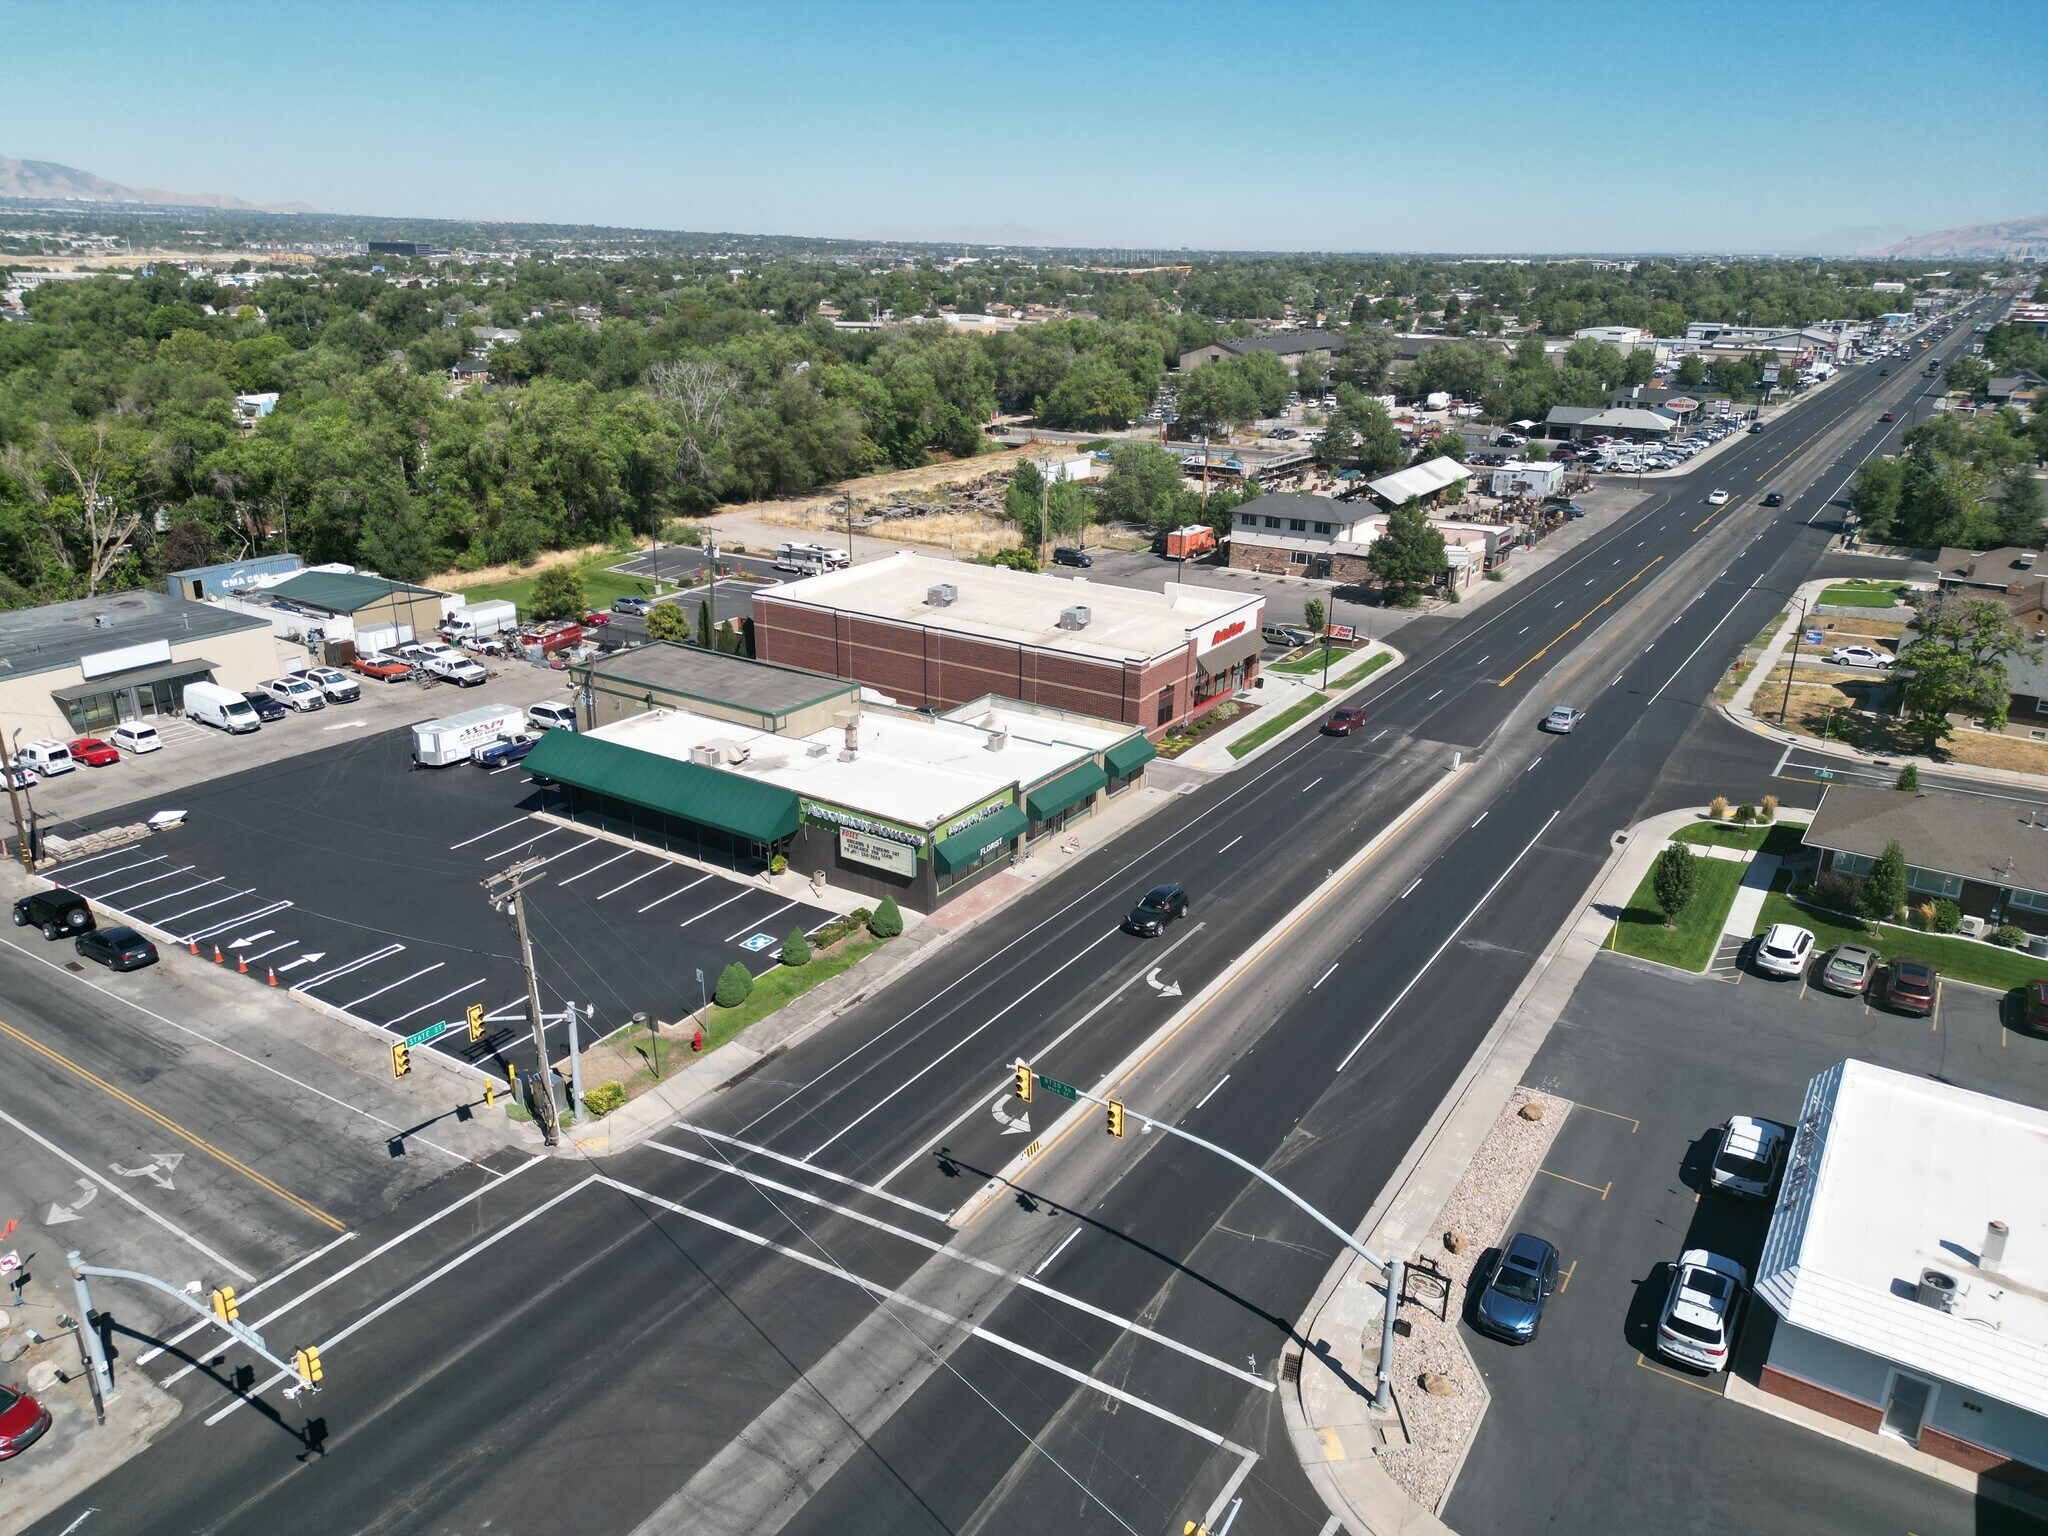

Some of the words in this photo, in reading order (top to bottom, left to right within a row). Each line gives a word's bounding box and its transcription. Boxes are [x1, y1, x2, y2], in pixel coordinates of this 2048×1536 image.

[222, 577, 245, 588] CMA
[980, 837, 1003, 856] FLORIST
[409, 1031, 429, 1045] STATE
[434, 1024, 443, 1033] ST
